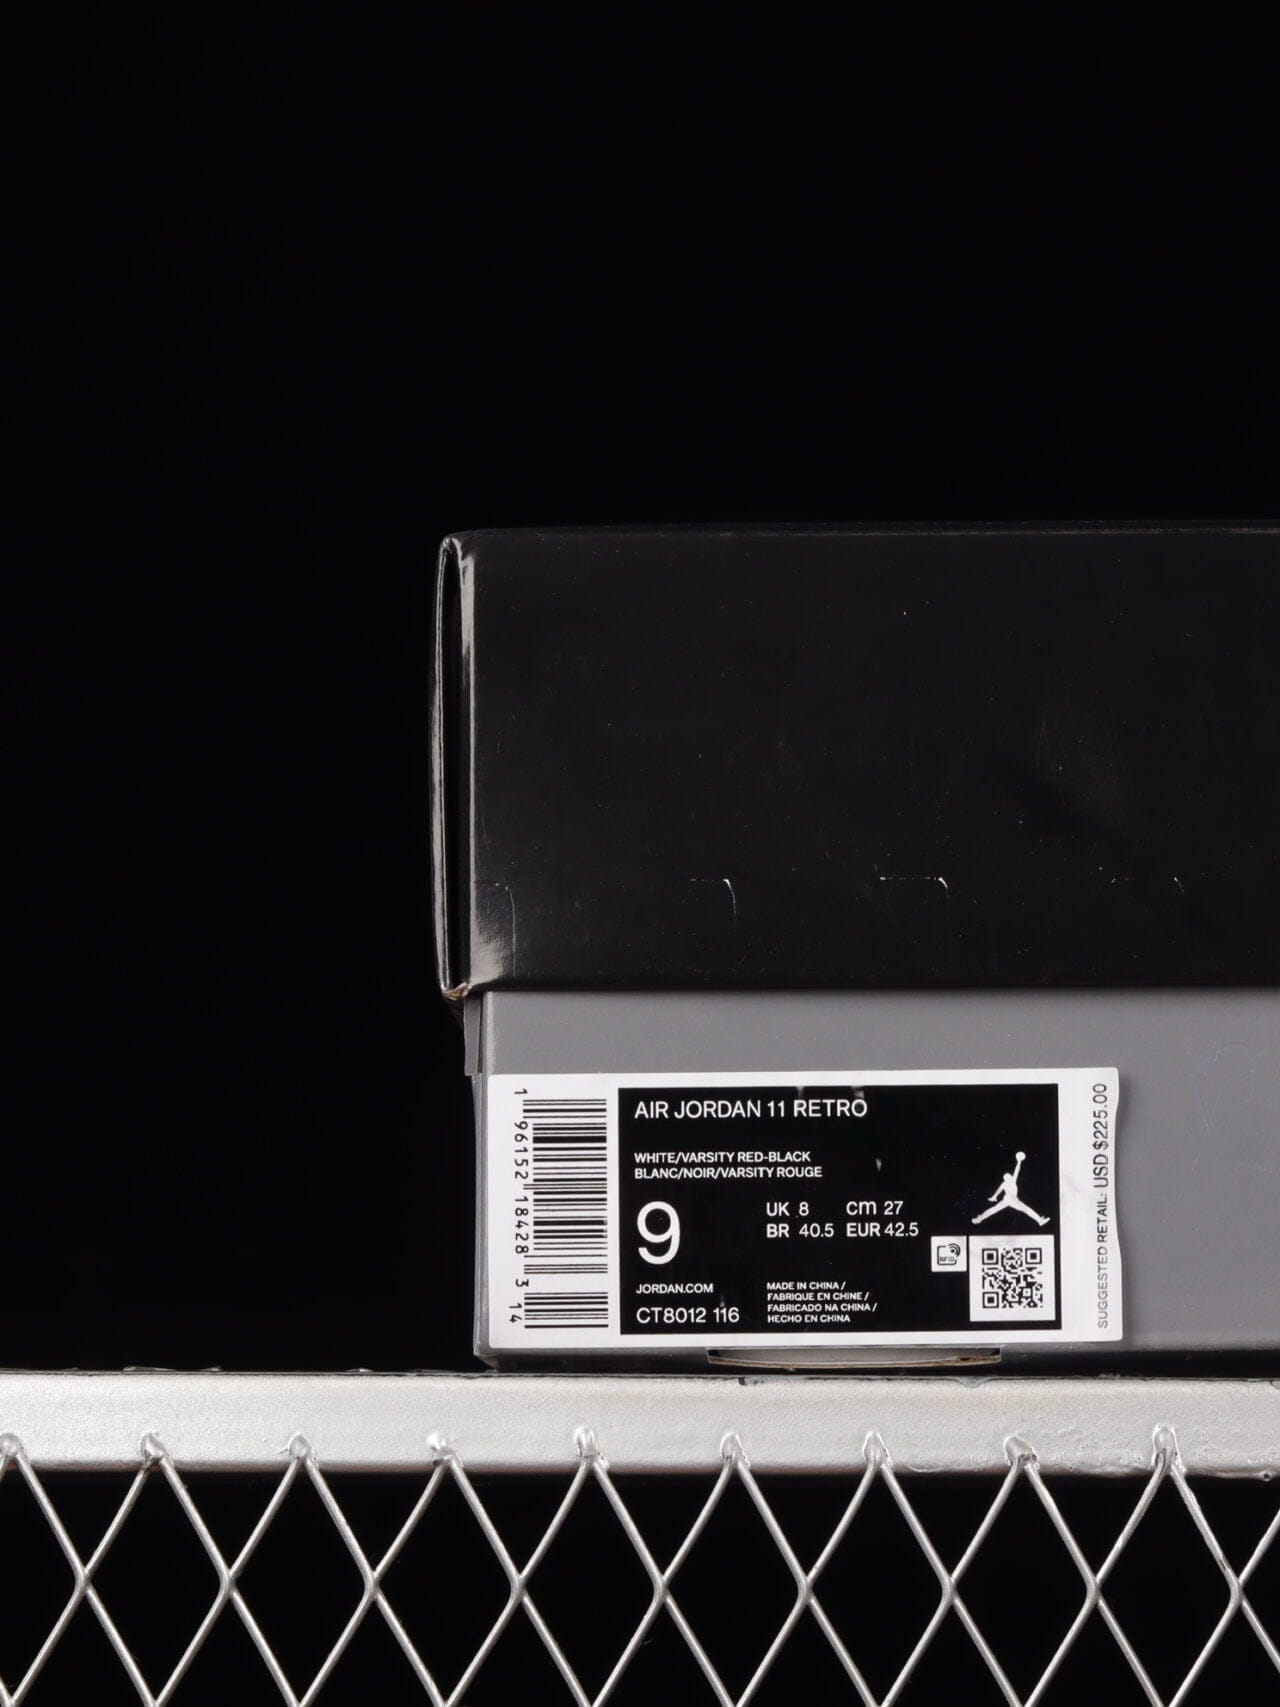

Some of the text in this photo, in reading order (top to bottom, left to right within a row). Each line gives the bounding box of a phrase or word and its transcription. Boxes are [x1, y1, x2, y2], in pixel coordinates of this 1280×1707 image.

[634, 1099, 868, 1119] AIR JORDAN 11 RETRO
[634, 1151, 811, 1164] WHITE/VARSITY RED-BLACK
[634, 1166, 823, 1180] BLANC/NOIR/VARSITY ROUGE
[513, 1088, 529, 1288] 1 96152 18428 3
[766, 1202, 809, 1216] UK 8
[884, 1201, 904, 1215] 27
[1092, 1083, 1109, 1329] SUGGESTED RETAIL: USD $225.00
[636, 1201, 681, 1265] 9
[766, 1223, 834, 1238] BR 40.5
[846, 1222, 919, 1237] EUR 42.5
[636, 1283, 714, 1294] JORDAN.COM
[767, 1282, 795, 1290] MADE
[797, 1282, 807, 1290] IN
[809, 1281, 839, 1290] CHINA
[767, 1293, 815, 1301] FABRIQUE
[817, 1292, 831, 1301] EN
[832, 1292, 863, 1301] CHINE
[509, 1302, 523, 1323] 14
[767, 1304, 822, 1312] FABRICADO
[825, 1304, 839, 1312] NA
[840, 1303, 871, 1312] CHINA
[636, 1307, 740, 1324] CT8012 116
[767, 1314, 851, 1323] HECHO EN CHINA
